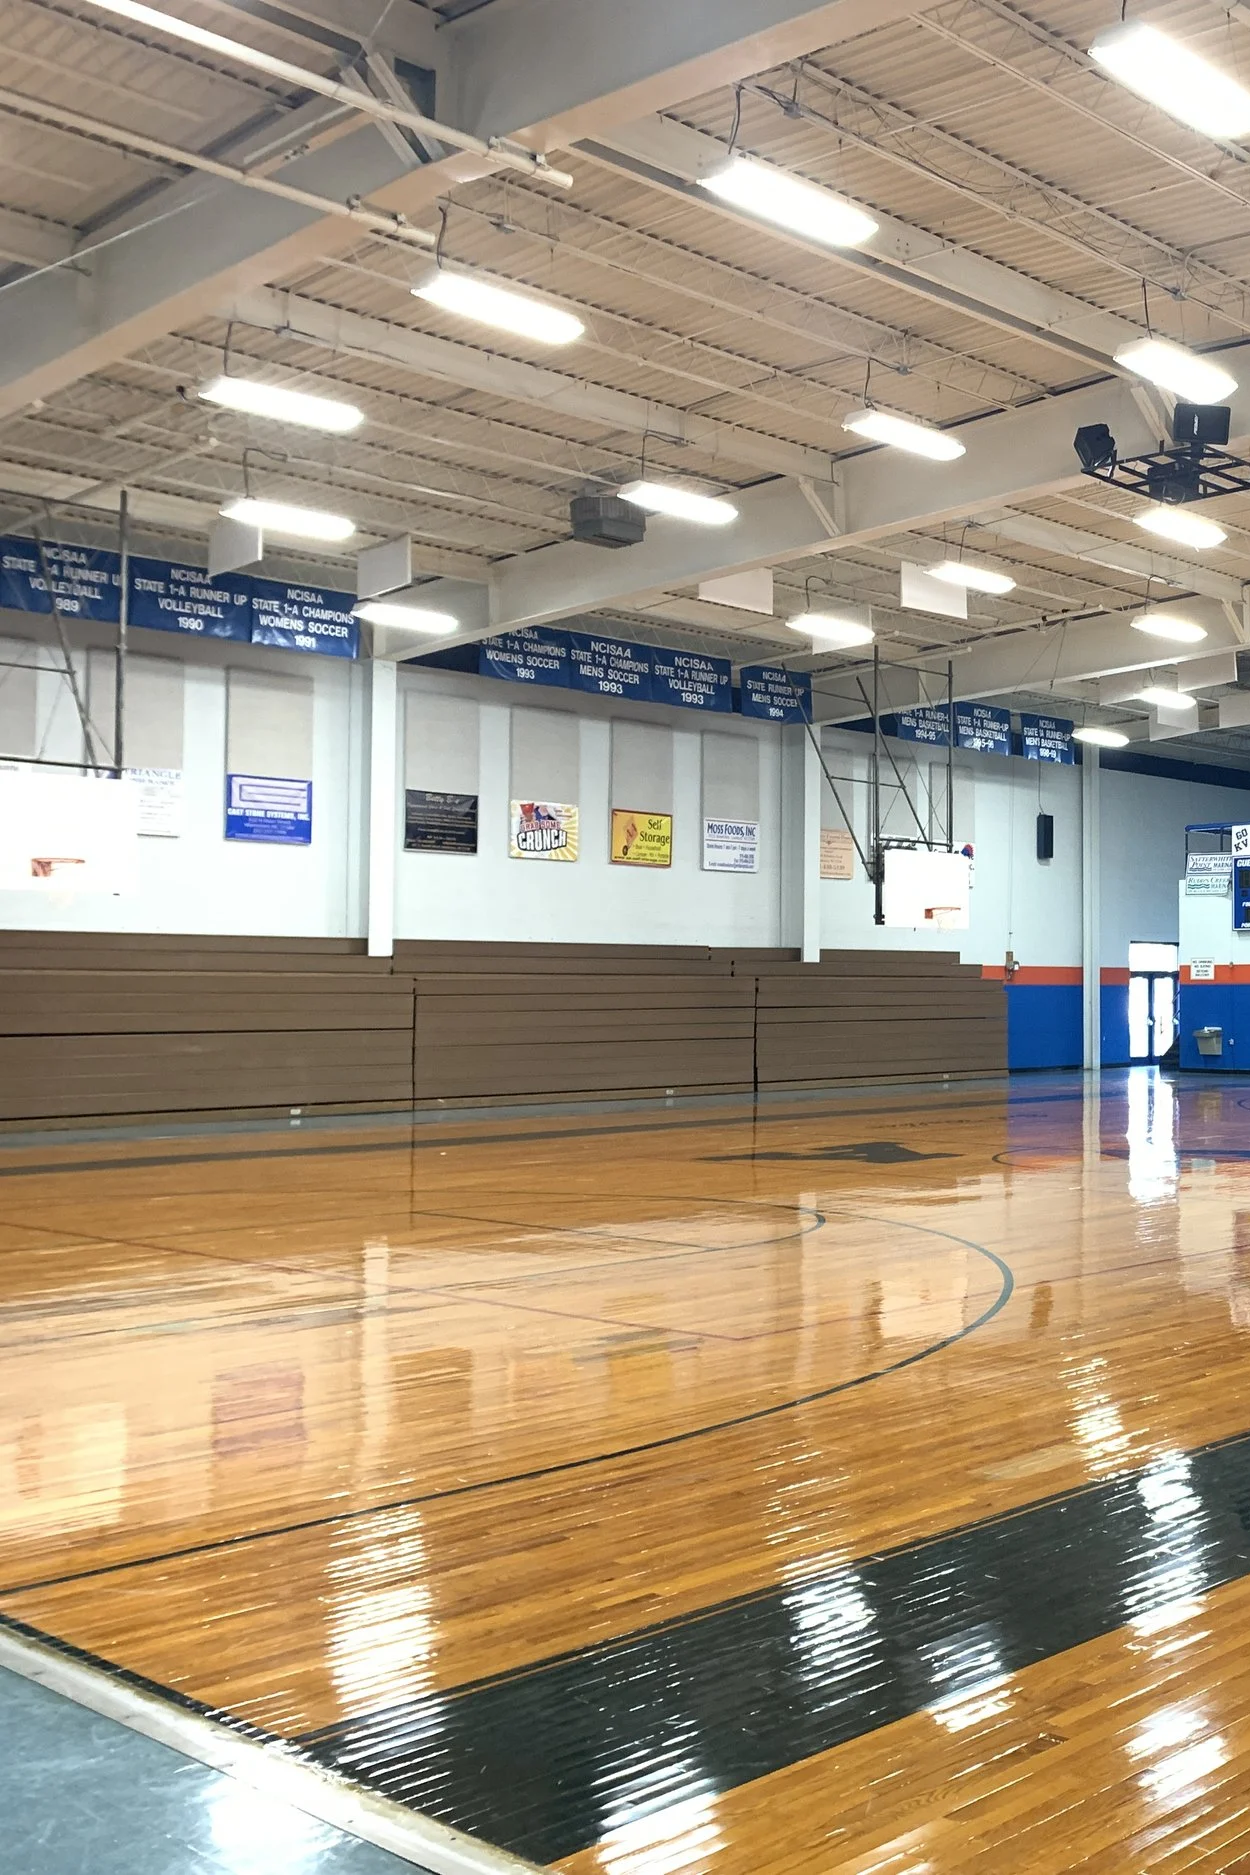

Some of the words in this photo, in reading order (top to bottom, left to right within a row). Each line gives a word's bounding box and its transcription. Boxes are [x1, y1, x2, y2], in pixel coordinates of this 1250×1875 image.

[2, 556, 37, 573] STATE
[170, 568, 212, 585] NCISAA
[134, 578, 165, 594] STATE
[169, 584, 186, 597] 1-A
[189, 586, 230, 604] RUNNER
[233, 594, 248, 606] UP
[286, 588, 324, 605] NCISAA
[158, 598, 224, 619] VOLLEYBALL
[252, 598, 280, 613] STATE
[284, 603, 299, 616] 1-A
[302, 606, 354, 625] CHAMPIONS
[177, 617, 205, 631] 1990
[259, 614, 304, 632] WOMENS
[308, 621, 348, 638] SOCCER
[294, 634, 317, 649] 1991
[482, 637, 504, 649] STATE
[507, 639, 520, 651] 1-A
[523, 641, 566, 658] CHAMPIONS
[590, 641, 632, 659] NCISAA
[486, 648, 523, 665] WOMENS
[526, 655, 560, 670] SOCCER
[571, 649, 592, 664] STATE
[595, 654, 608, 666] 1-A
[610, 656, 650, 674] CHAMPIONS
[674, 656, 714, 672] NCISAA
[516, 667, 536, 680] 1993
[579, 664, 605, 679] MENS
[607, 669, 640, 685] SOCCER
[654, 664, 675, 677] STATE
[677, 668, 689, 680] 1-A
[691, 671, 718, 684] RUNNER
[719, 674, 729, 685] UP
[762, 671, 787, 684] NCISAA
[598, 680, 624, 695] 1993
[668, 677, 716, 696] VOLLEYBALL
[746, 680, 767, 693] STATE
[768, 685, 793, 697] RUNNER
[681, 692, 704, 706] 1993
[751, 692, 772, 705] MENS
[768, 707, 785, 718] 1994
[957, 715, 971, 727] STATE
[975, 728, 1007, 742] BASKETBALL
[1023, 727, 1039, 737] STATE
[1041, 739, 1069, 752] BASKETBALL
[648, 818, 663, 831] Self
[707, 823, 725, 835] MOSS
[724, 824, 745, 837] FOODS,
[745, 826, 757, 837] INC
[518, 829, 568, 851] CRUNCH
[639, 831, 670, 847] Storage
[1235, 828, 1248, 840] GO
